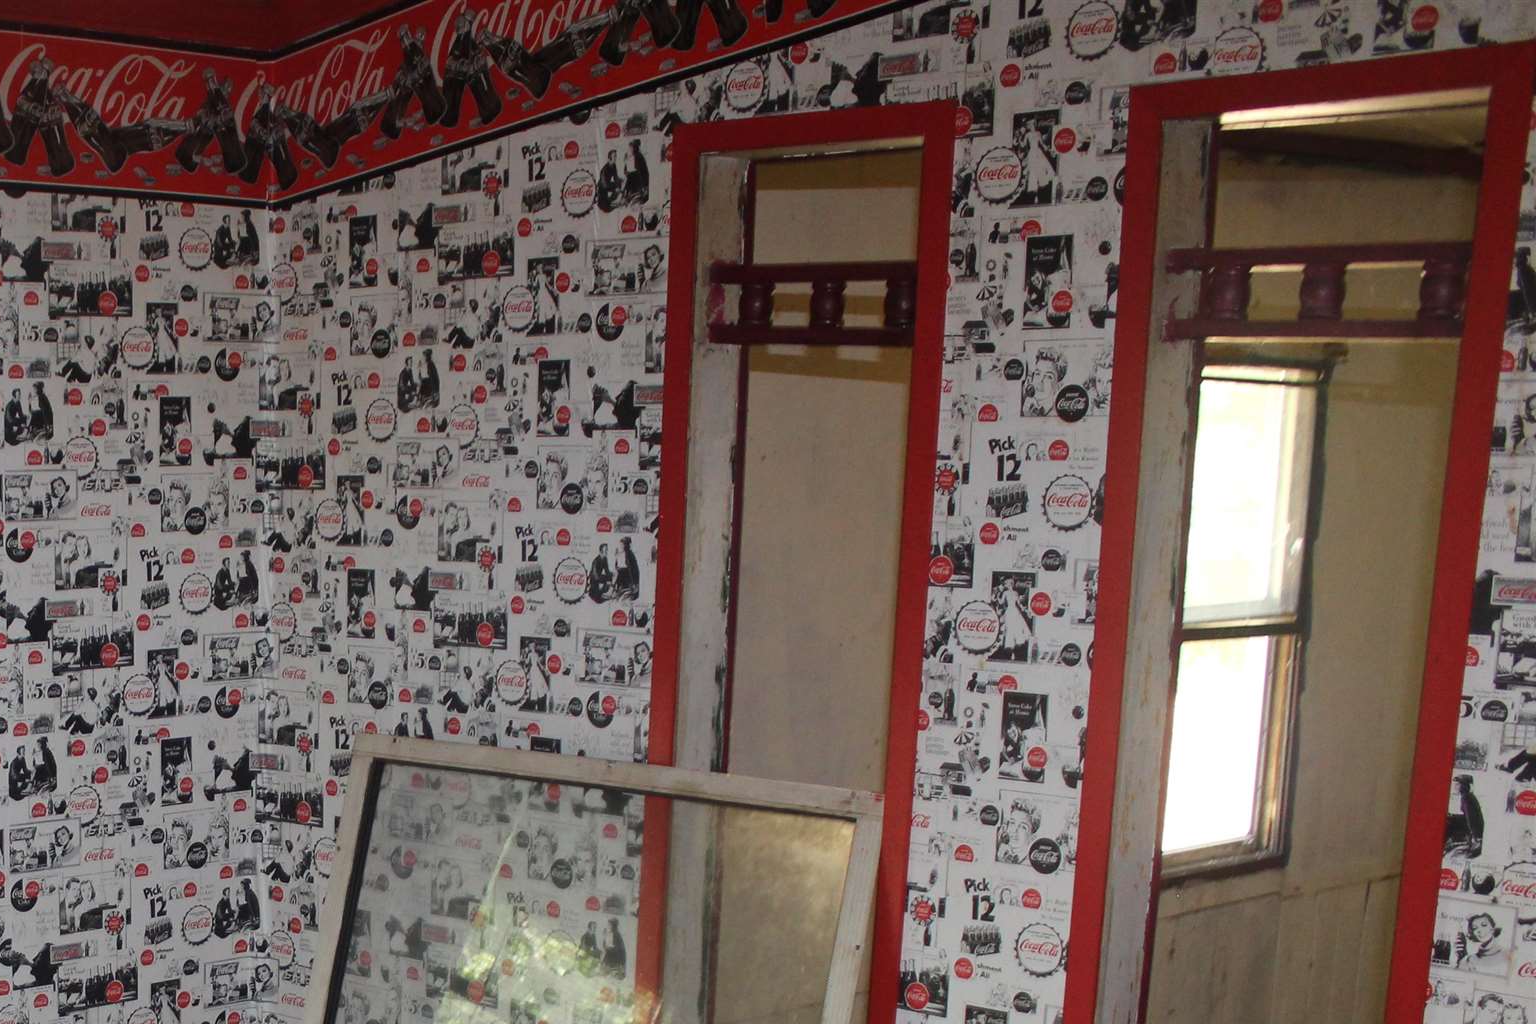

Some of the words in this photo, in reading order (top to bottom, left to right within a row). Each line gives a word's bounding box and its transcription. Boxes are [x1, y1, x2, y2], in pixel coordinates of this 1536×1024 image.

[1072, 20, 1115, 37] Coca-Cola
[1216, 48, 1260, 62] Coca-Cola
[0, 44, 197, 129] Cca-Cola
[234, 26, 391, 143] Cca-Cola
[522, 142, 541, 157] Pick
[528, 157, 545, 182] 12
[978, 165, 1019, 181] Coca-Cola
[1057, 397, 1086, 410] Coca-Cola
[989, 437, 1016, 455] Pick
[997, 454, 1021, 481] 12
[1047, 493, 1088, 508] Coca-Cola
[515, 524, 533, 539] Pick
[140, 548, 160, 563] Pick
[522, 539, 538, 561] 12
[147, 560, 164, 581] 12
[1030, 849, 1060, 863] Coca-Cola
[143, 885, 163, 899] Pick
[964, 878, 989, 893] Pick
[150, 897, 167, 918] 12
[972, 895, 995, 922] 12
[1020, 941, 1060, 956] Coca-Cola
